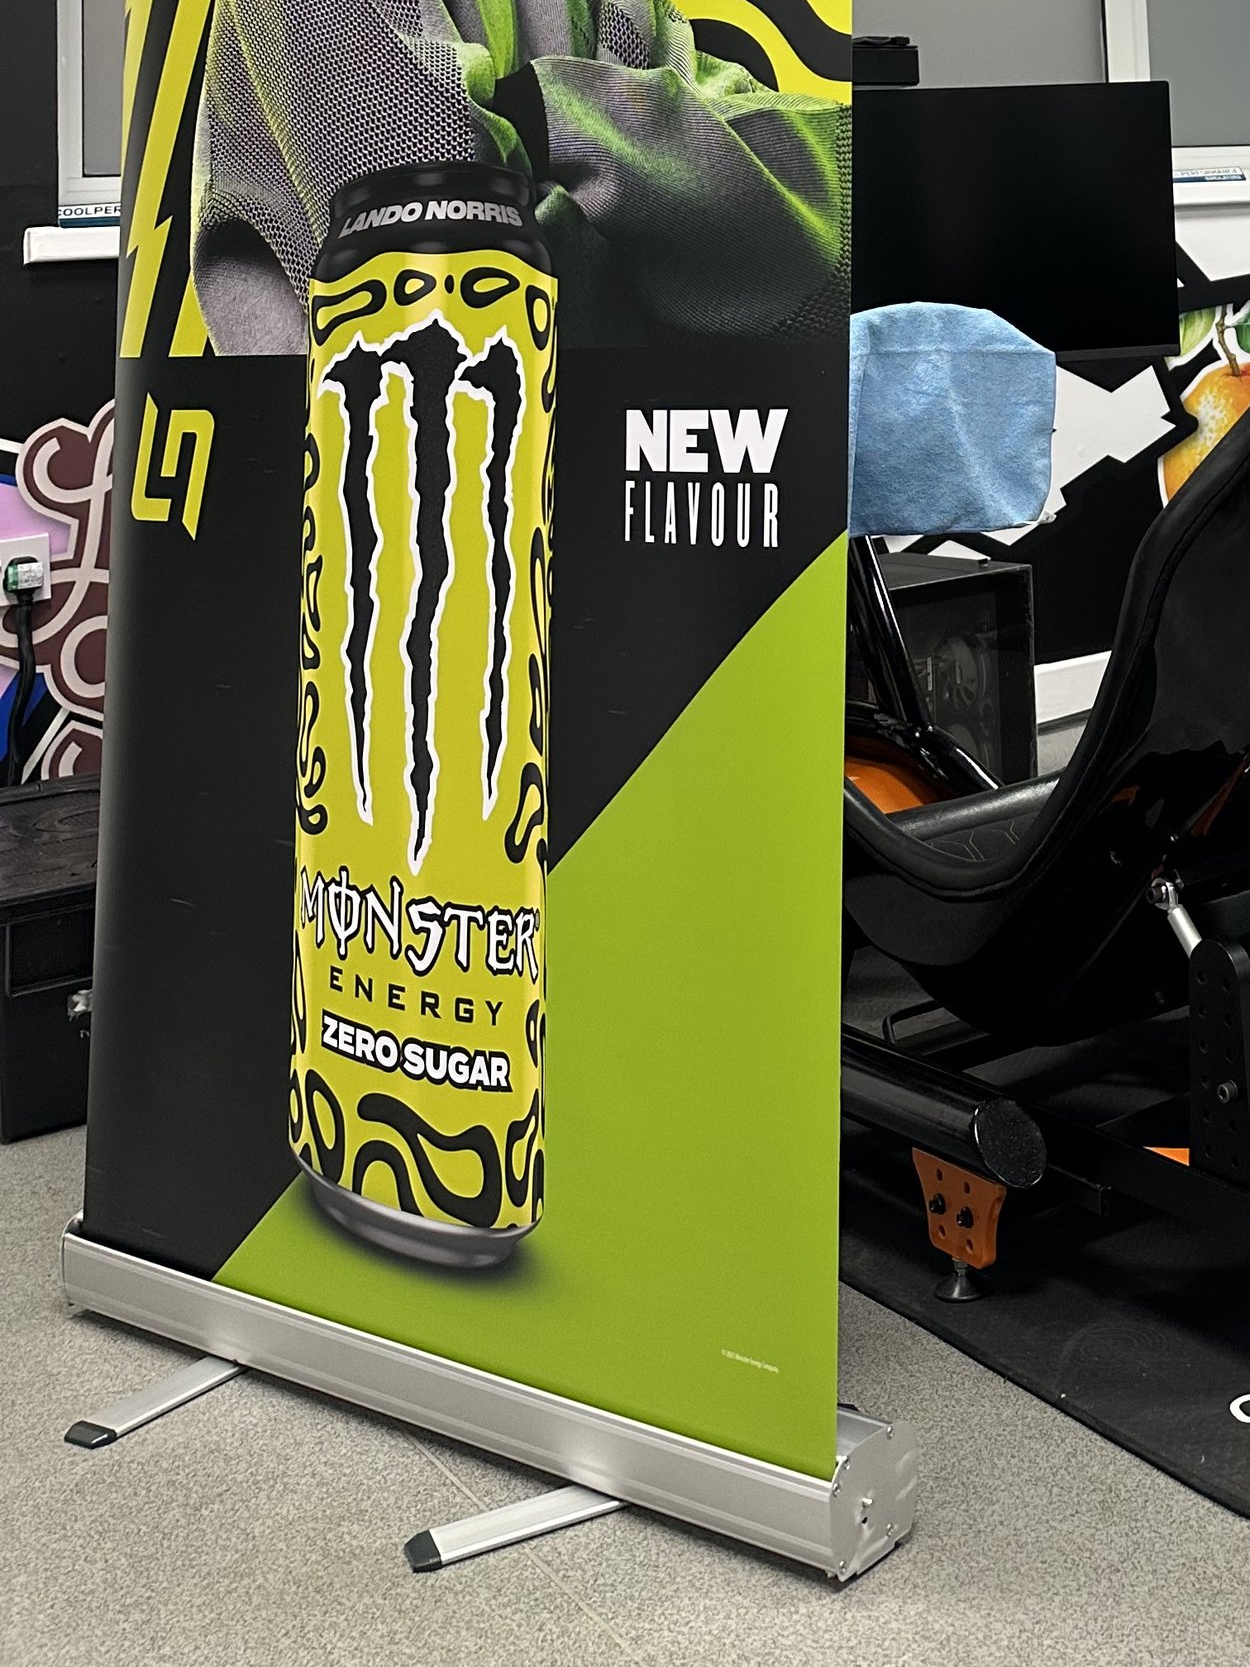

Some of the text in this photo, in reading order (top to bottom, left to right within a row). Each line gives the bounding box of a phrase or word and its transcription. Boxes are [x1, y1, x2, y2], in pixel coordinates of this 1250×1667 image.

[338, 200, 523, 239] LANDO NORRIS
[625, 409, 789, 474] NEW
[624, 480, 778, 547] FLAVOUR
[299, 867, 541, 986] MONSTER
[329, 965, 503, 1026] ENERGY
[322, 1014, 510, 1088] ZERO SUGAR
